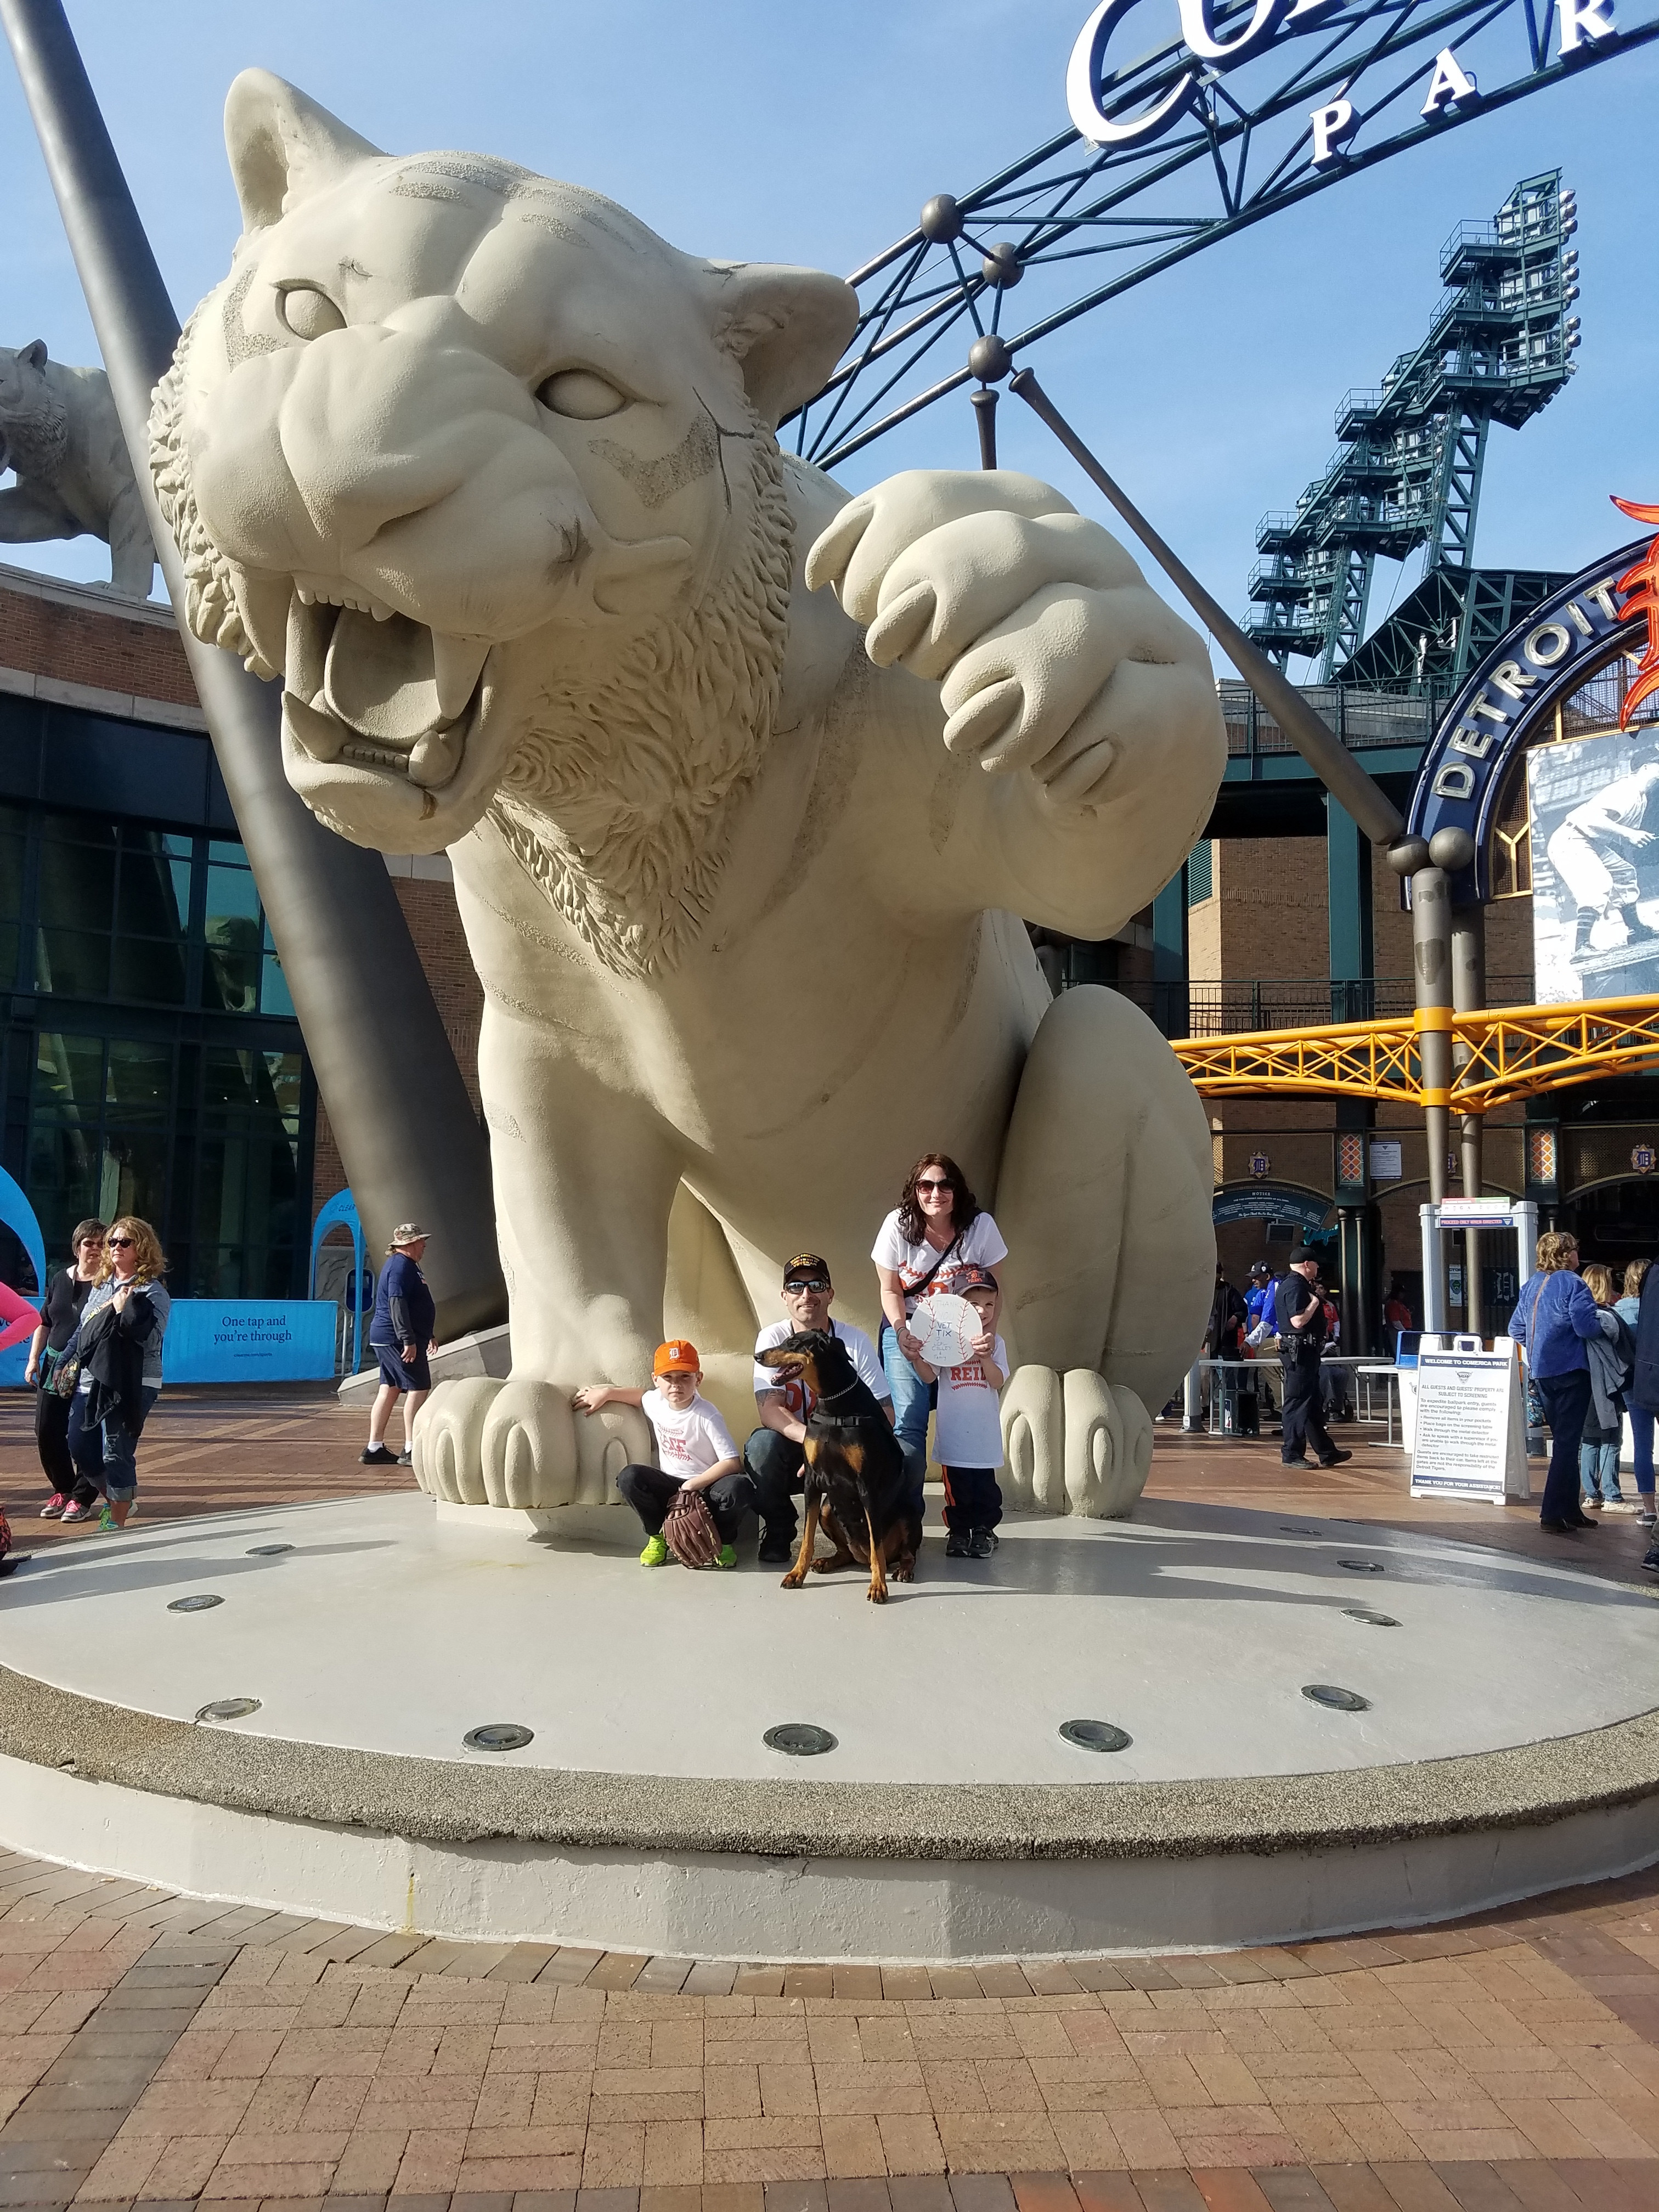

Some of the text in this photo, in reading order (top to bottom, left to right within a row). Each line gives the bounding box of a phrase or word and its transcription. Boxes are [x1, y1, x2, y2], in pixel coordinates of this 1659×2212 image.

[1431, 576, 1618, 800] DETROIT
[222, 1315, 286, 1329] One tap and
[213, 1330, 292, 1345] you're through
[669, 1347, 679, 1360] D
